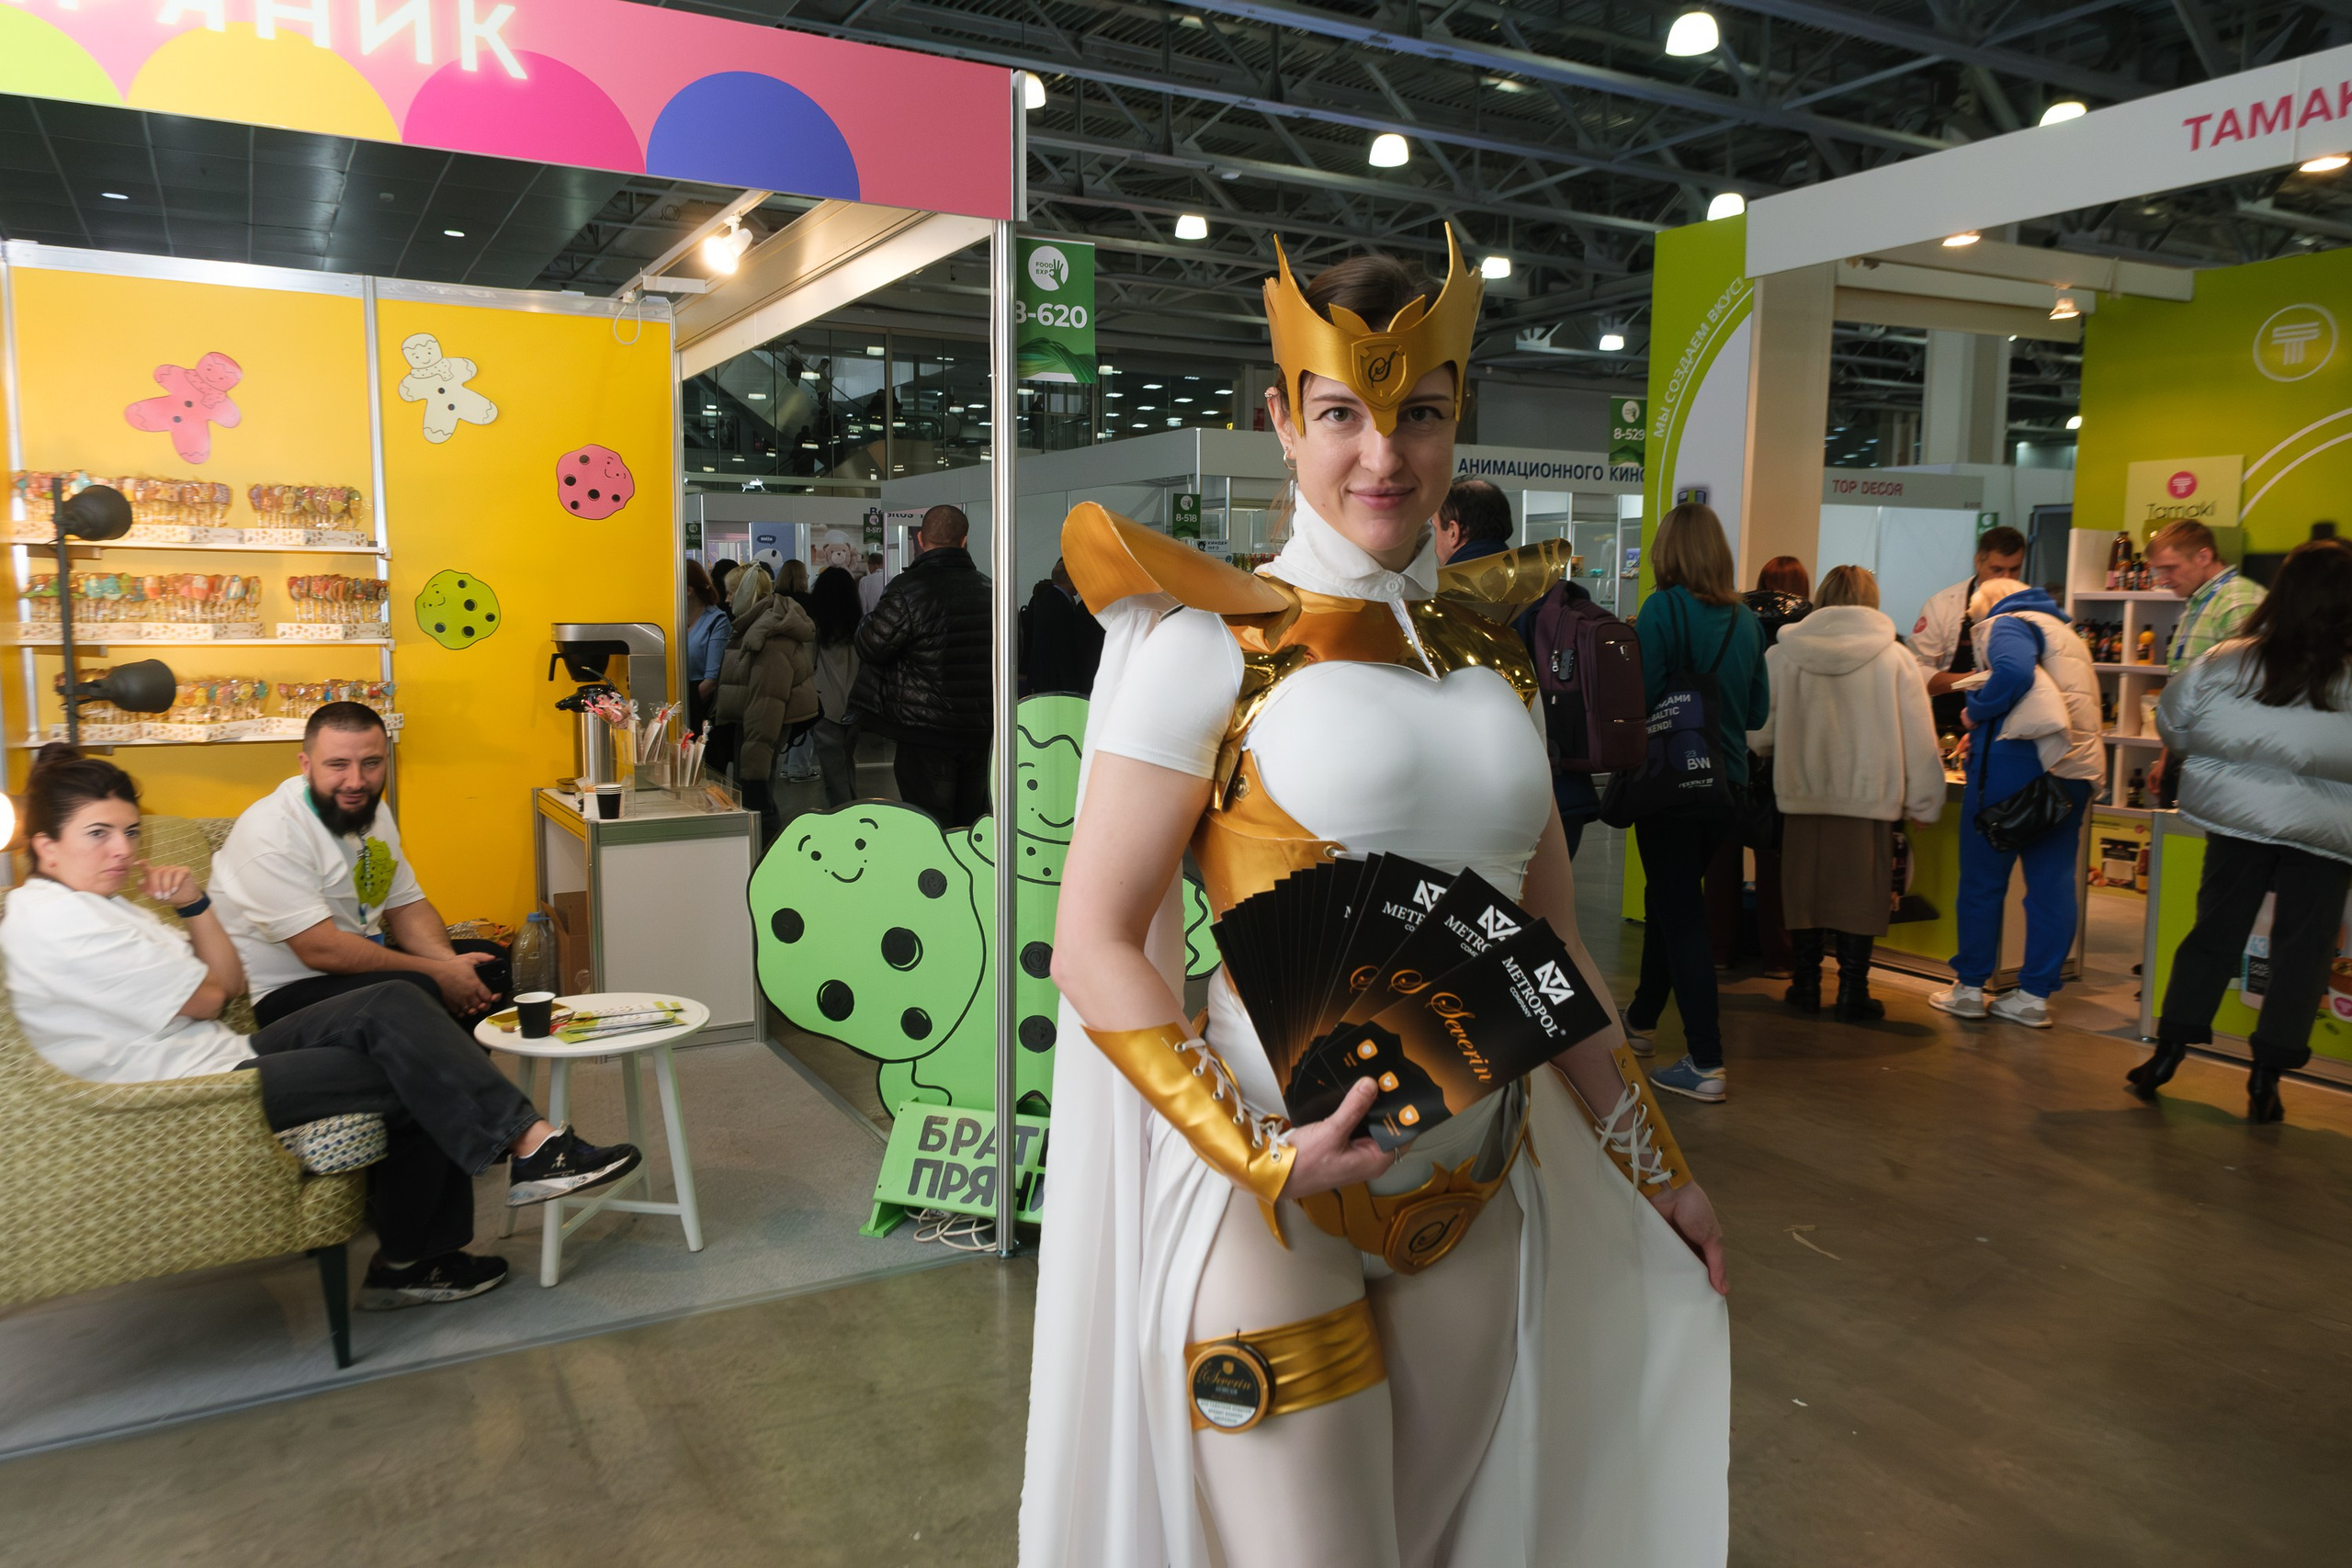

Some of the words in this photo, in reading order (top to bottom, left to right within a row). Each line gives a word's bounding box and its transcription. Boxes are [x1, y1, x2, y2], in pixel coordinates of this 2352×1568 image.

[1654, 407, 1671, 438] МЫ
[1665, 322, 1710, 403] СОЗДАЕМ
[1458, 458, 1603, 481] АНИМАЦИОННОГО
[1832, 479, 1857, 494] TOP
[1861, 481, 1905, 497] DECOR
[1176, 513, 1197, 523] 8-518
[1687, 757, 1711, 771] BW
[1501, 956, 1559, 1038] METROPOL
[1510, 986, 1532, 1018] COMPANY
[1425, 992, 1492, 1085] Severin
